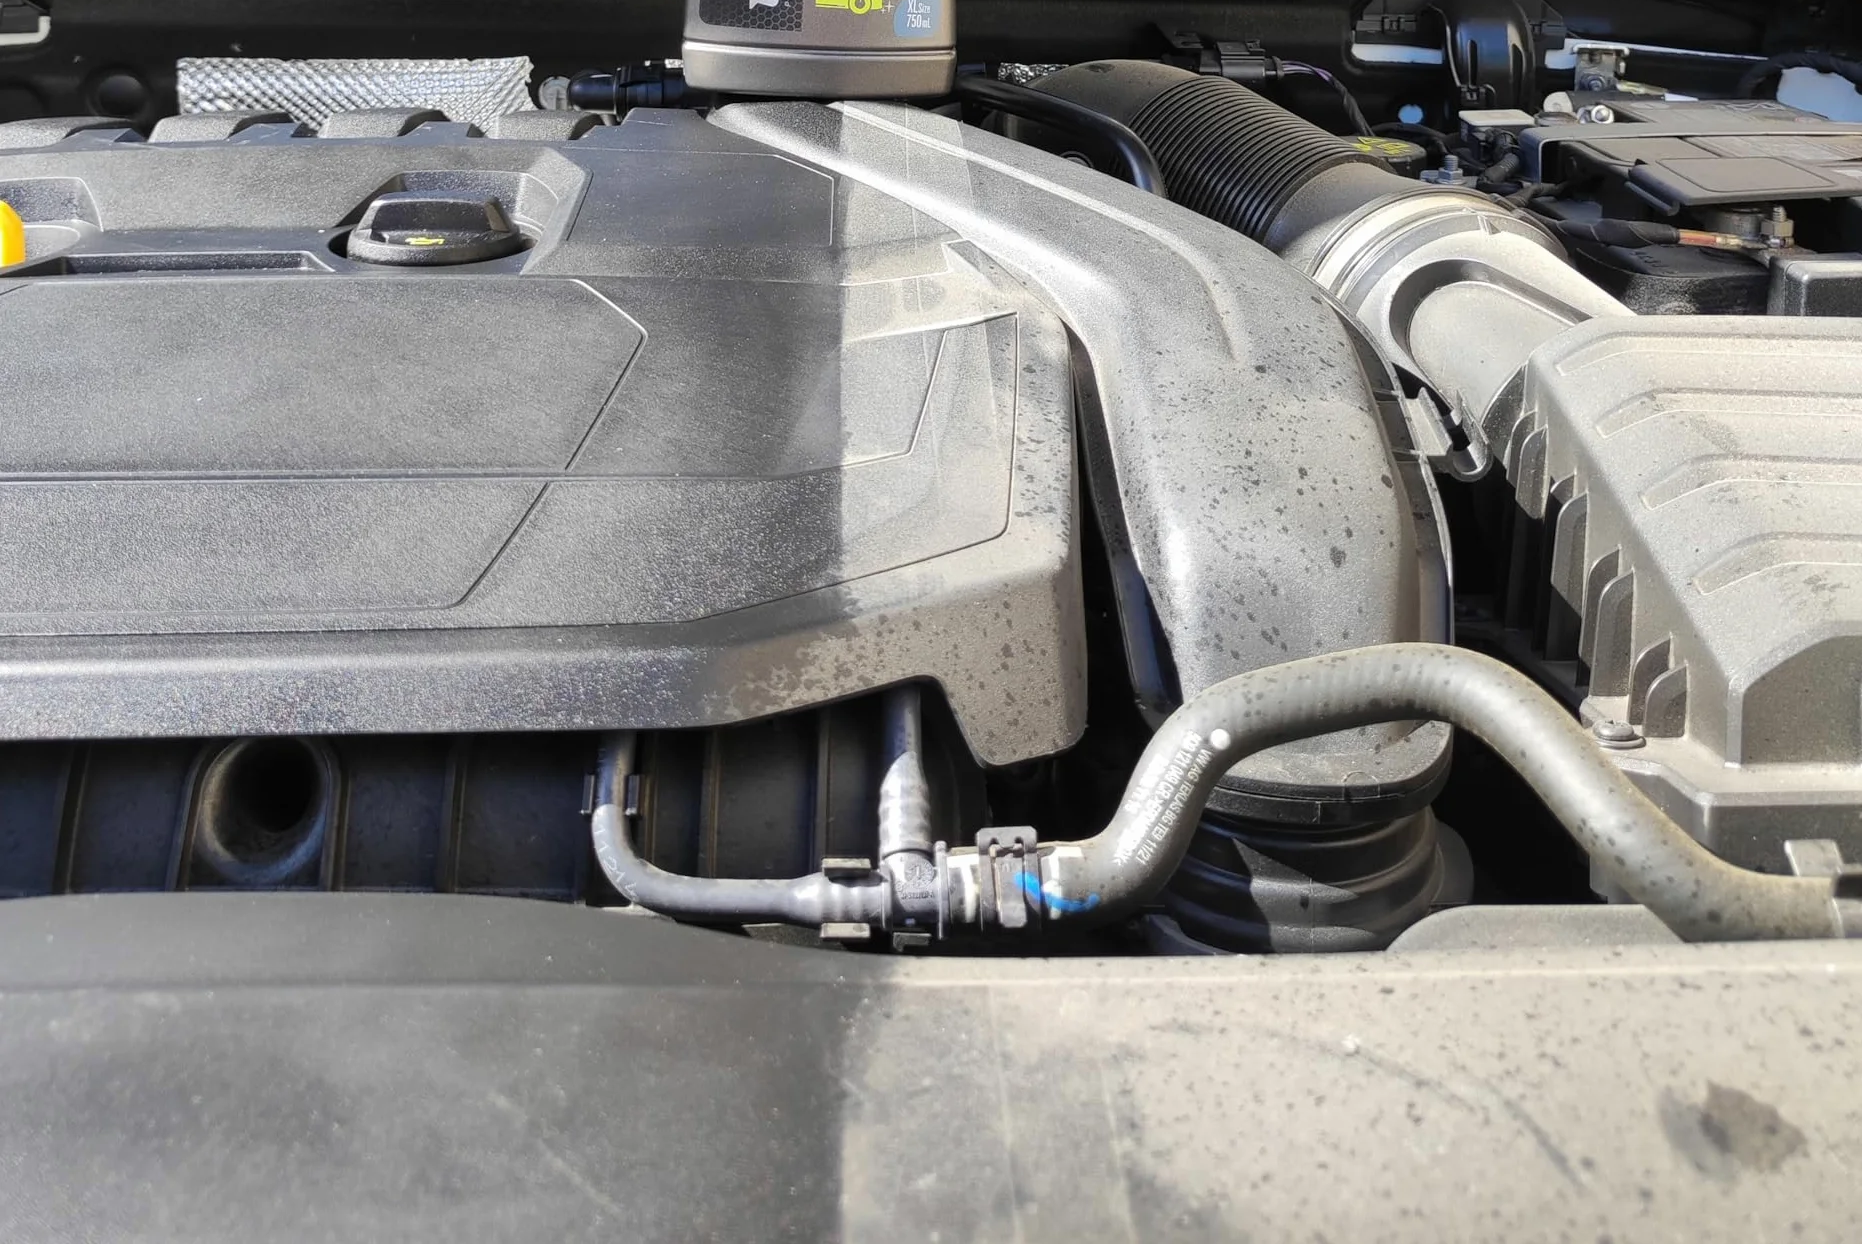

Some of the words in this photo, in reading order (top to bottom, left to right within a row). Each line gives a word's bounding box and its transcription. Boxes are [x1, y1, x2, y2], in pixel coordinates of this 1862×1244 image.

[1173, 749, 1192, 767] 121
[1195, 748, 1211, 766] VW
[1163, 764, 1183, 784] 049
[1187, 764, 1202, 781] AG
[1168, 780, 1193, 812] TEKLAS
